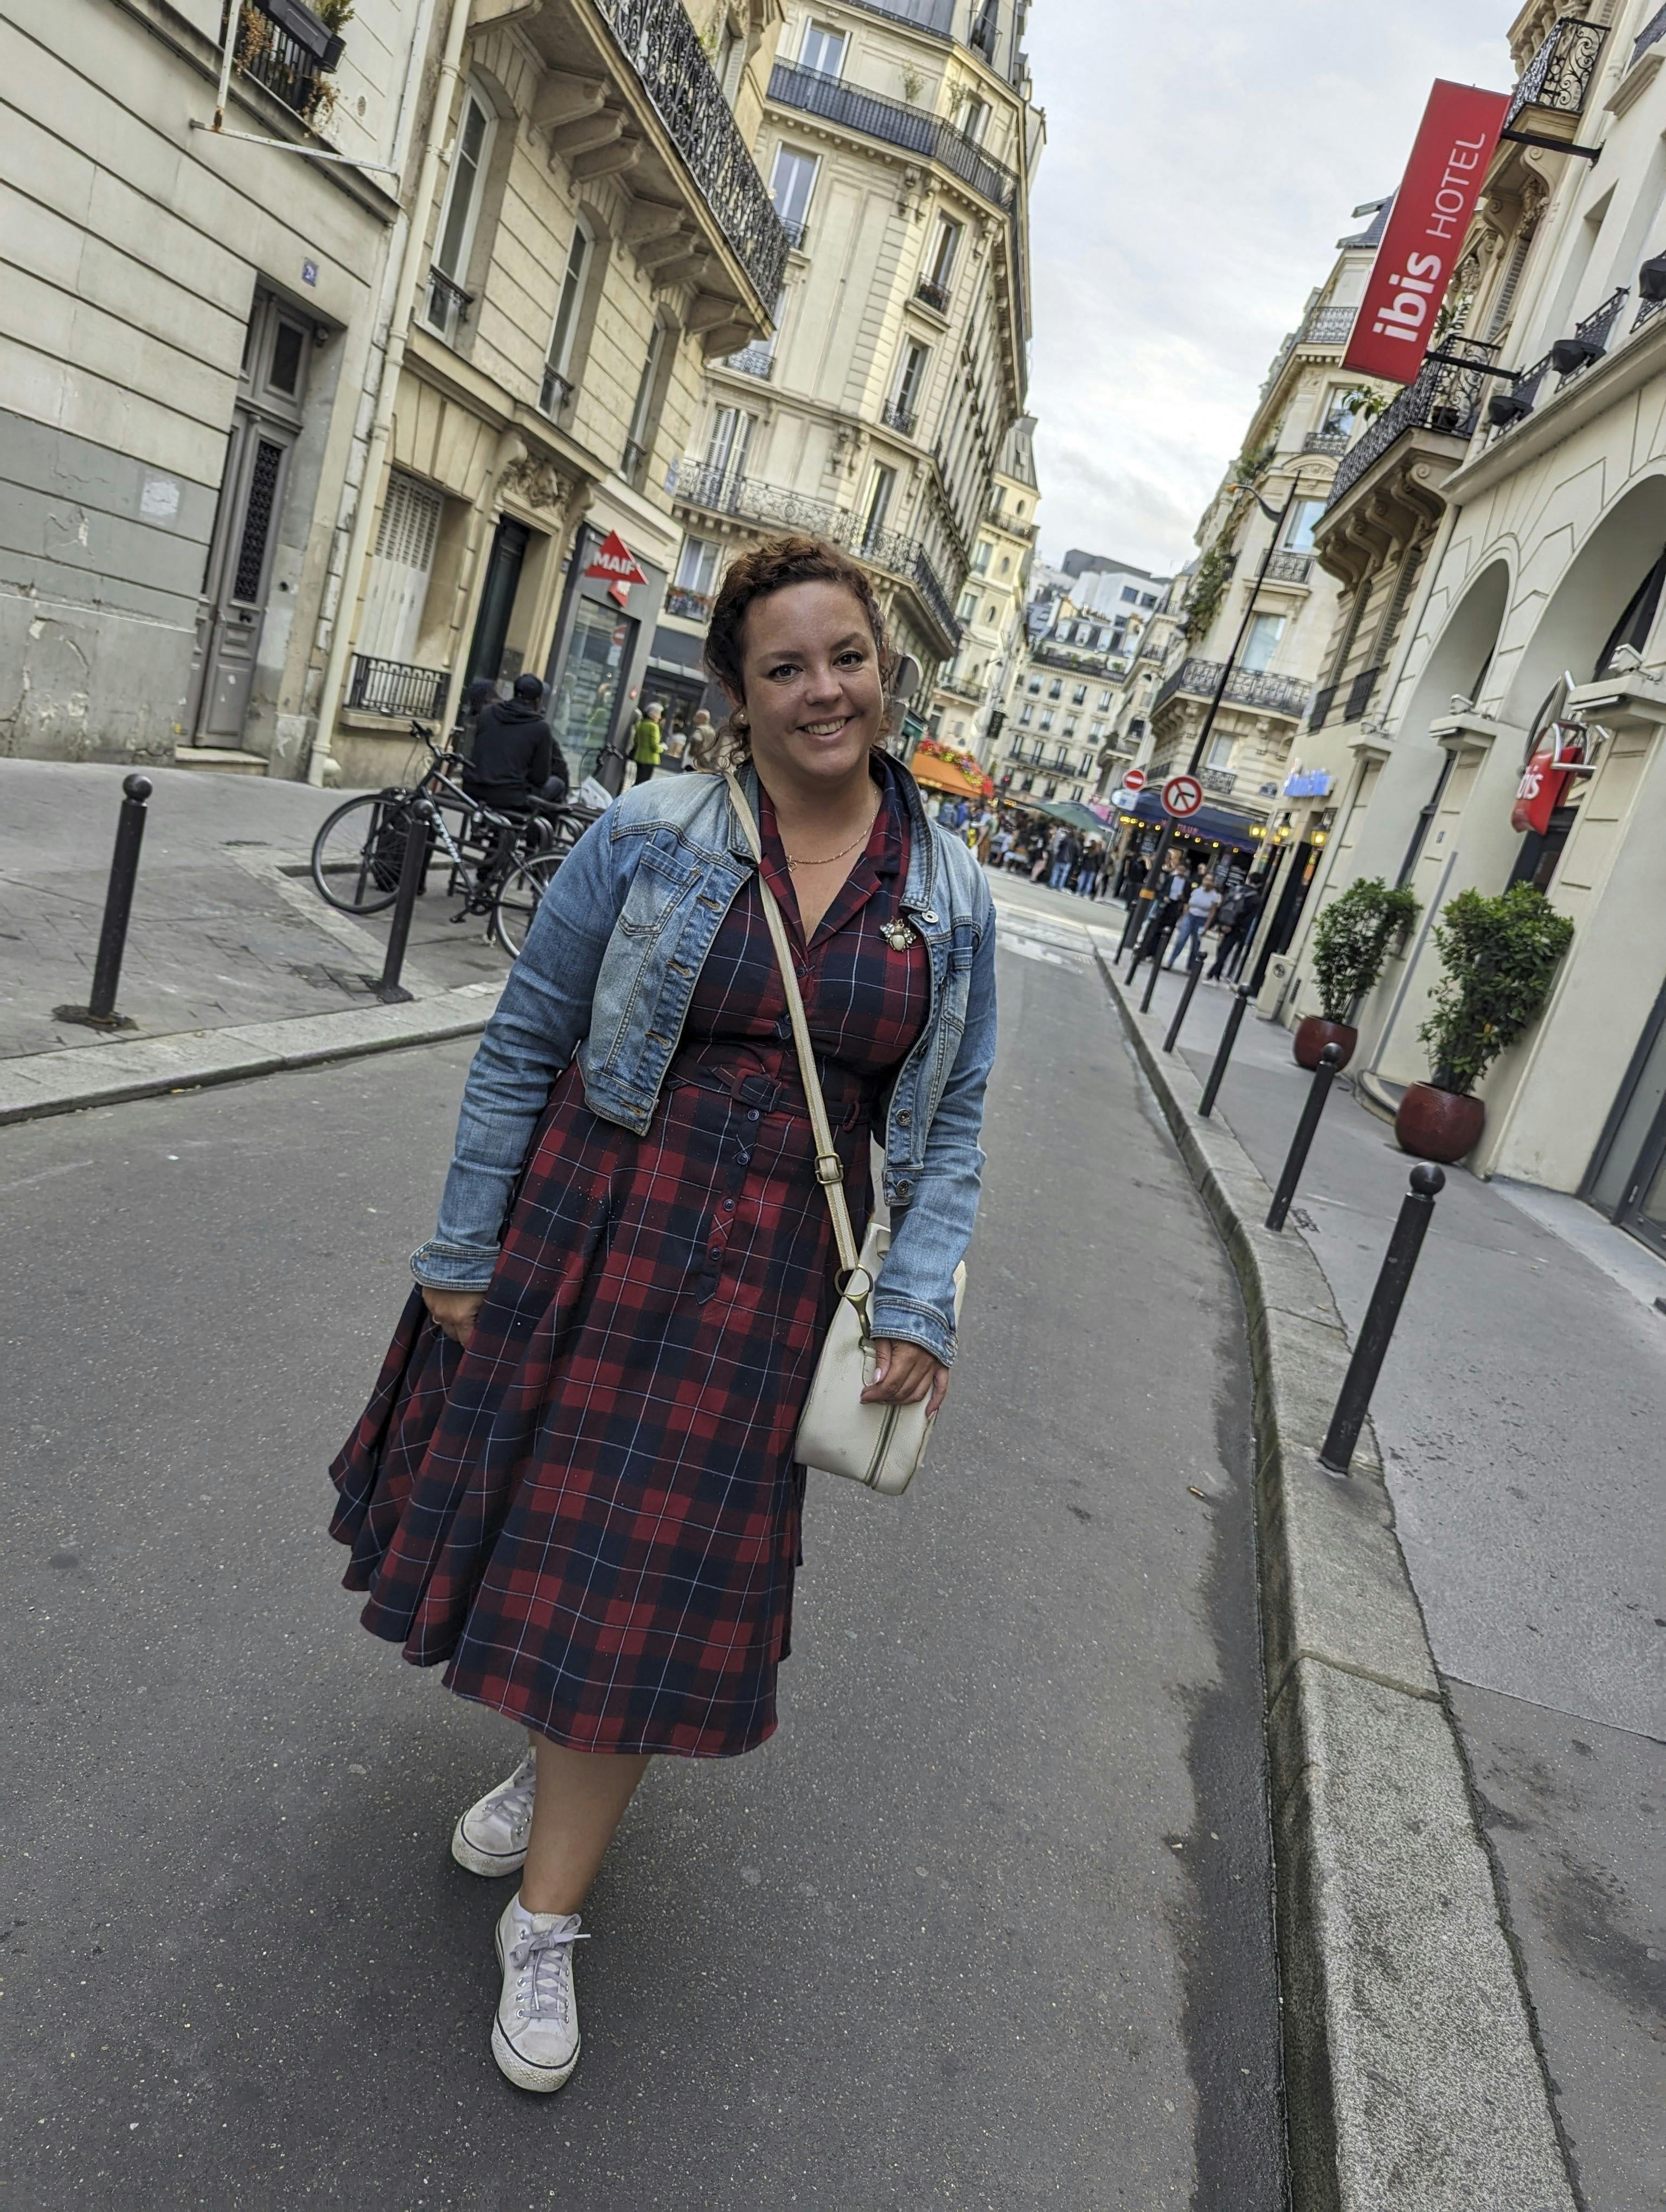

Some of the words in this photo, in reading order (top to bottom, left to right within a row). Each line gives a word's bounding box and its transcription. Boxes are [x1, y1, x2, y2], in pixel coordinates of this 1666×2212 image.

[1373, 252, 1443, 342] ibis
[1425, 132, 1485, 239] HOTEL
[593, 551, 636, 575] MAIF
[1516, 765, 1544, 799] bis
